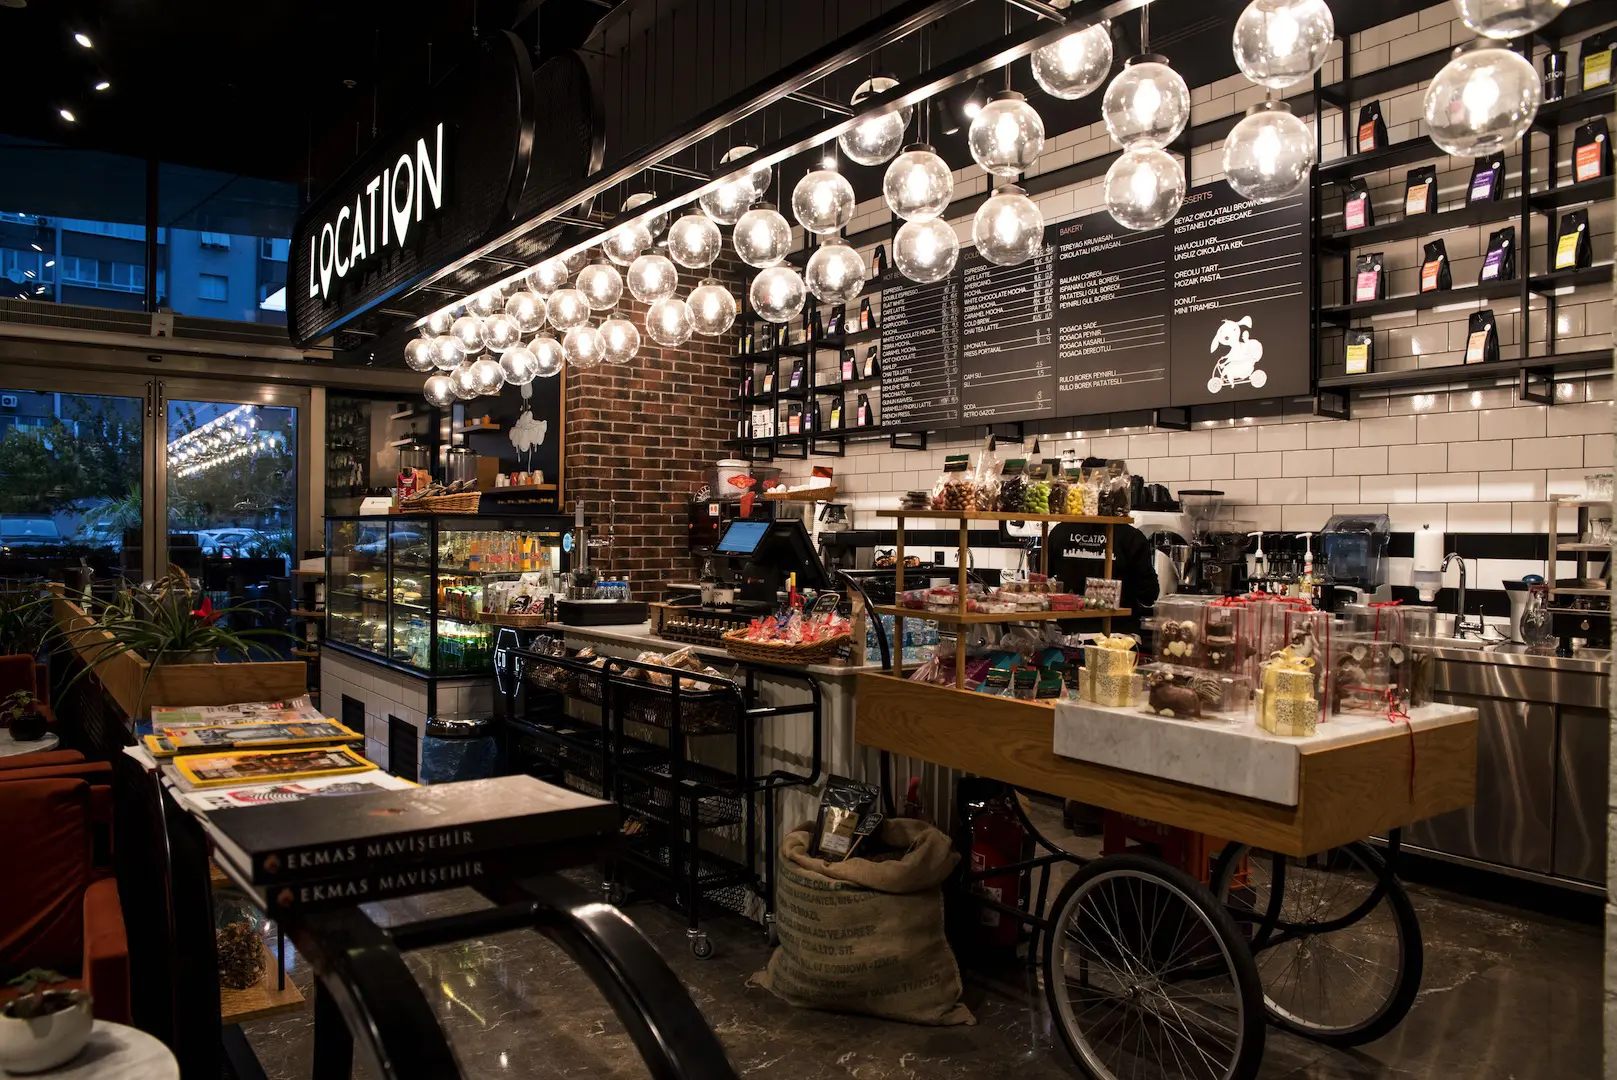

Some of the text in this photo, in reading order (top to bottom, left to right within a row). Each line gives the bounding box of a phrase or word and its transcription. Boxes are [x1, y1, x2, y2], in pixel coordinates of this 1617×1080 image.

[309, 122, 443, 300] LOCATION
[1174, 215, 1194, 226] BEYAZ
[1194, 205, 1233, 220] CIKOLATALI
[1174, 210, 1253, 234] KESTANELI CHEESECAKE
[1060, 224, 1083, 236] BAKERY
[1060, 241, 1083, 252] TEREYAG
[1083, 234, 1114, 246] KRUVASAN
[1174, 236, 1219, 252] HAVUCLU KEK
[1060, 247, 1091, 260] CIKOLATALI
[1091, 241, 1120, 253] KRUVASAN
[1174, 240, 1245, 262] UNSUZ CIKOLATA KEK
[964, 264, 987, 276] ESPRESSO
[1174, 264, 1219, 280] OREOLU TART
[964, 271, 991, 283] CAFE LATTE
[1060, 270, 1102, 285] BALKAN COREGI
[1174, 273, 1221, 289] MOZAIK PASTA
[883, 285, 903, 295] ESPRESSO
[964, 279, 991, 290] AMERICANO
[1060, 275, 1120, 293] ISPANAKLI GUL BOREGI
[964, 289, 982, 298] MOCHA
[964, 297, 978, 305] WHITE
[978, 290, 1007, 302] CHOCOLATE
[1007, 286, 1026, 296] MOCHA
[1060, 290, 1087, 301] PATATESLI
[1088, 287, 1099, 295] GUL
[1100, 284, 1120, 293] BOREGI
[1060, 299, 1081, 309] PEYNIRLI
[1082, 296, 1093, 304] GUL
[1094, 293, 1115, 302] BOREGI
[1174, 295, 1197, 306] DONUT
[964, 305, 978, 314] ZEBRA
[978, 301, 997, 310] MOCHA
[964, 307, 1004, 321] CARAMEL MOCHA
[1174, 301, 1220, 315] MINI TIRAMISU
[964, 319, 977, 328] COLD
[977, 317, 990, 325] BREW
[975, 325, 985, 333] TEA
[985, 323, 999, 331] LATTE
[1060, 321, 1097, 334] POGACA SADE
[883, 328, 898, 336] MOCHA
[895, 331, 919, 340] CHOCOLATE
[920, 328, 935, 336] MOCHA
[1060, 329, 1102, 342] POGACA PEYNIR
[901, 346, 916, 354] MOCHA
[964, 341, 987, 350] LIMONATA
[1060, 338, 1106, 350] POGACA KASARLI
[964, 350, 978, 358] PRESS
[977, 346, 1001, 355] PORTAKAL
[1060, 345, 1111, 358] POGACA DEREOTLU
[1060, 370, 1117, 383] RULO BOREK PEYNIRLI
[1060, 378, 1122, 391] RULO BOREK PATATESLI
[964, 410, 978, 418] RETRO
[979, 409, 996, 417] GAZOZ
[287, 845, 356, 870] EKMAS
[300, 877, 369, 903] EKMAS
